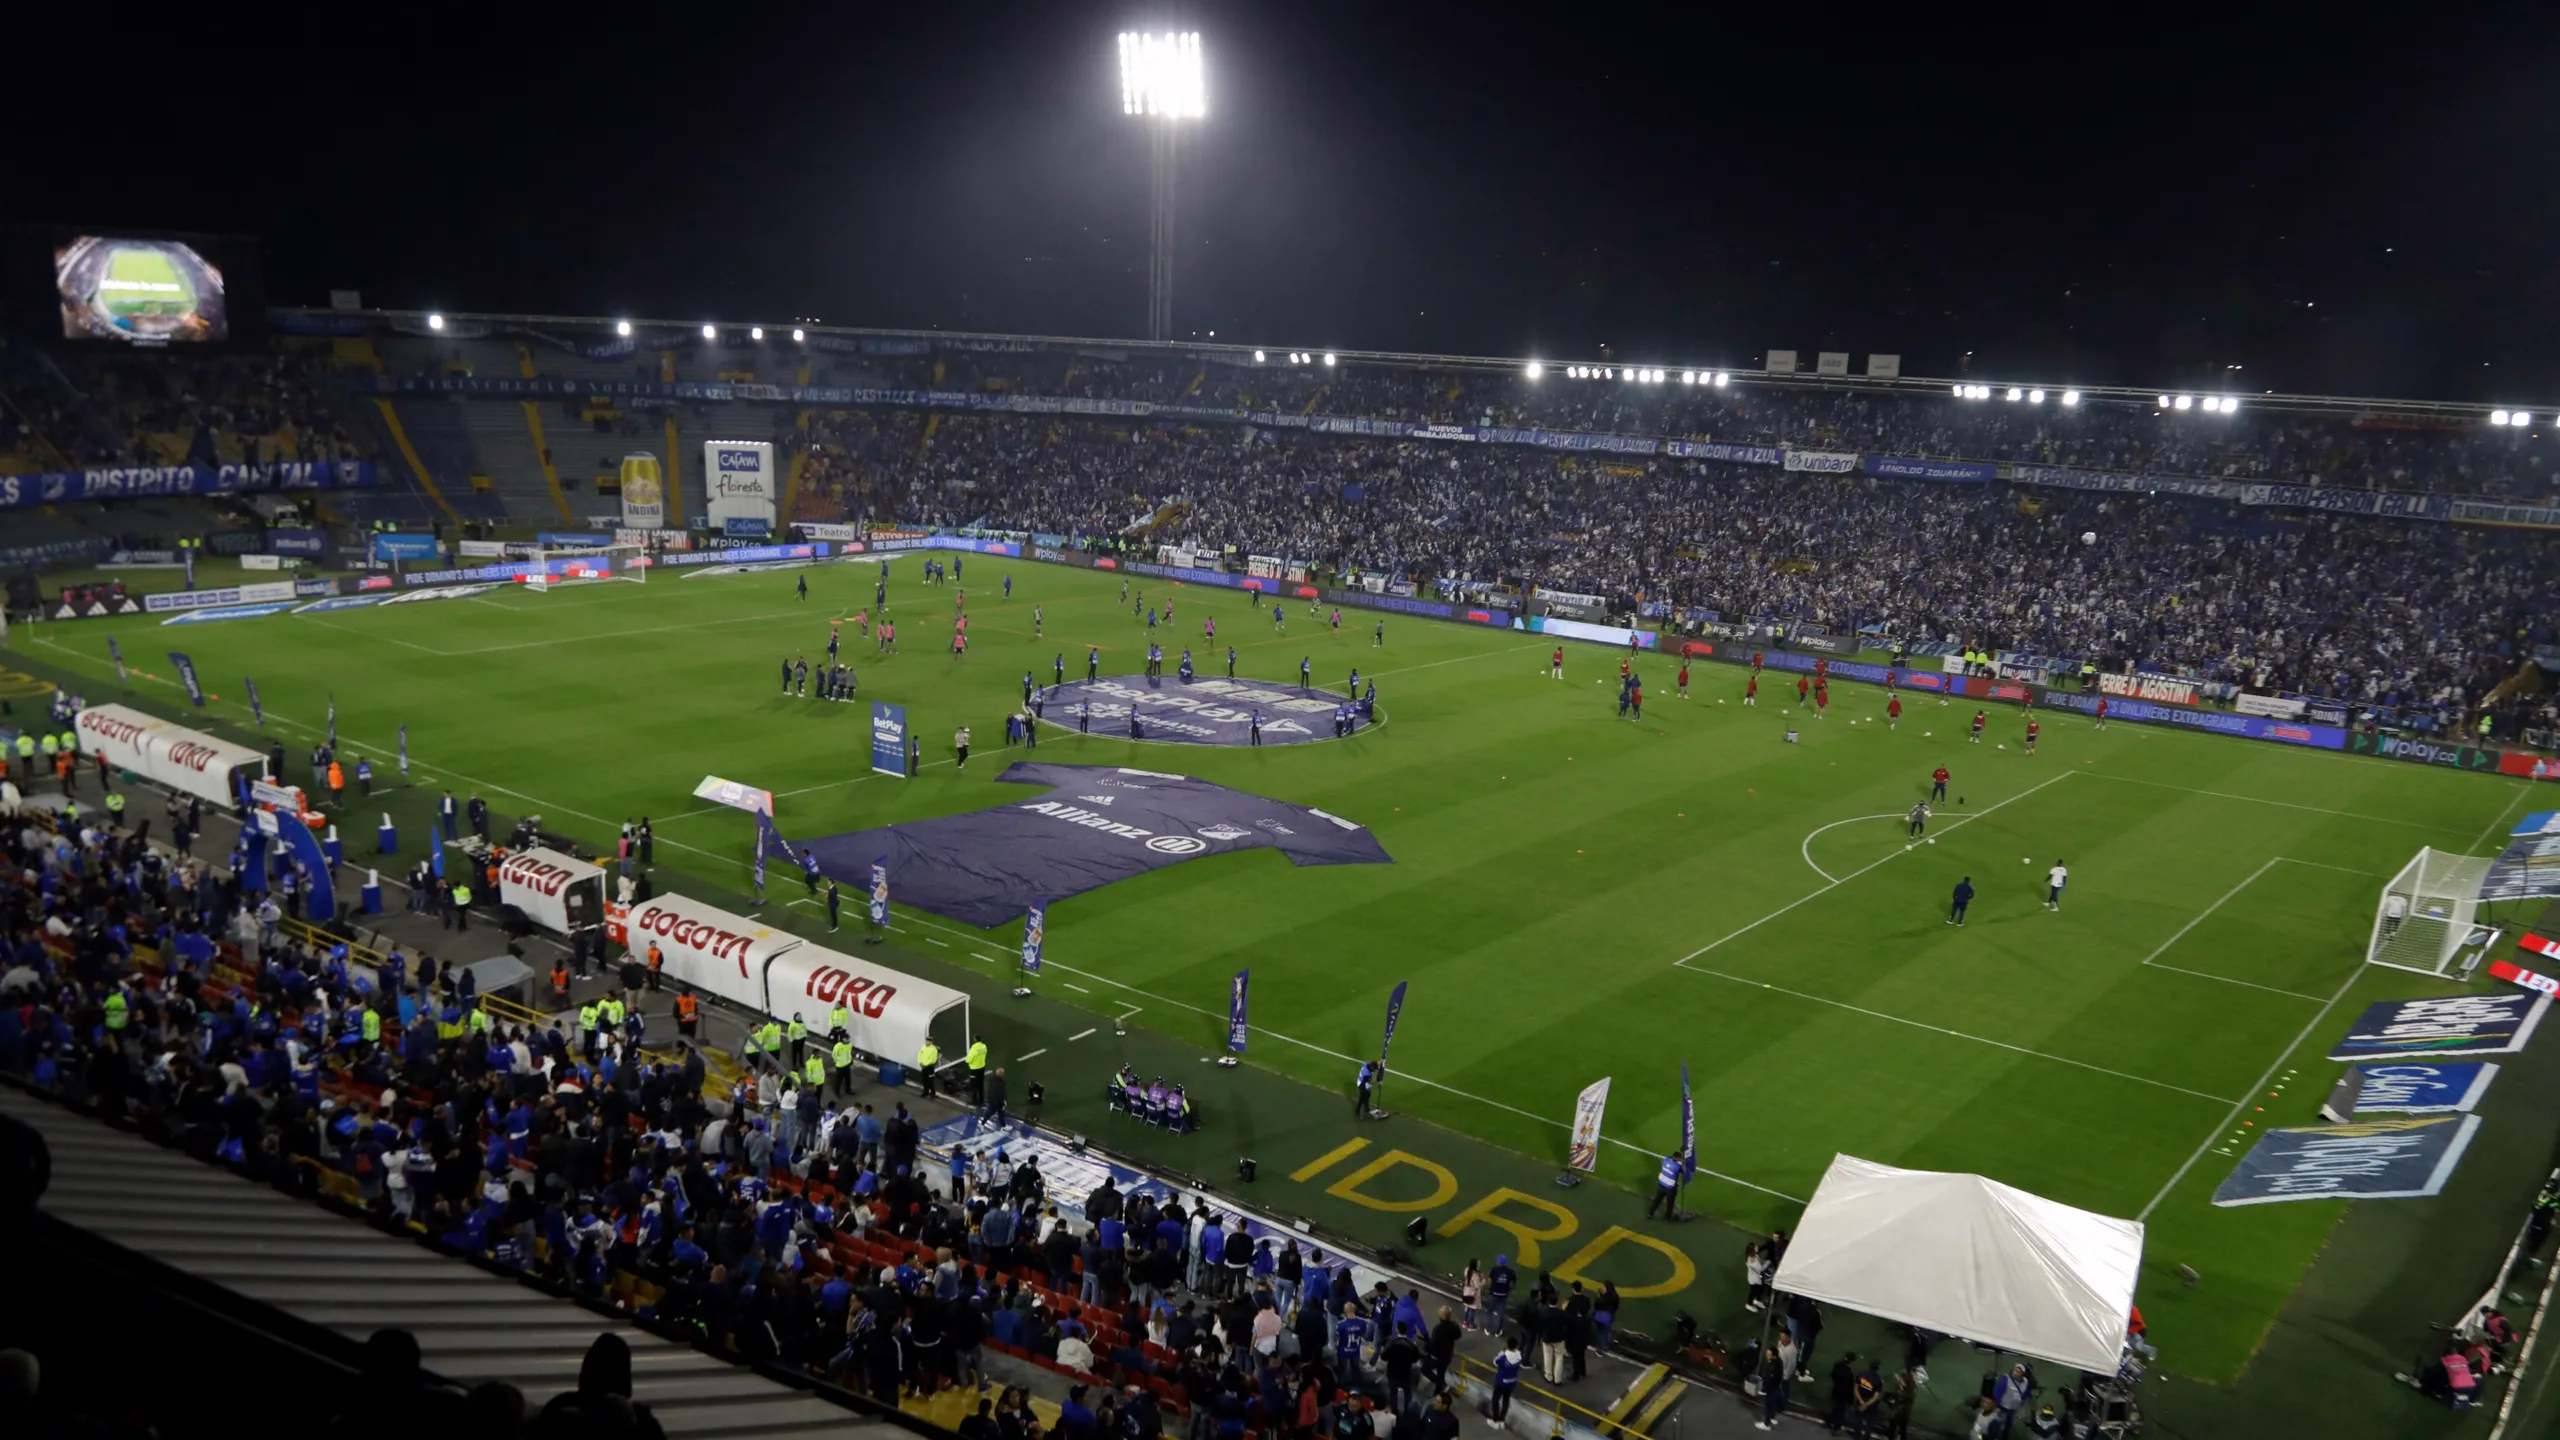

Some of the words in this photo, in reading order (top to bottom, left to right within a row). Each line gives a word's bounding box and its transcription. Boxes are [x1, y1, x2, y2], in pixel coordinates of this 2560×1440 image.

[1413, 430, 1476, 442] EMBAJADORES
[1428, 424, 1463, 434] NUEVOS
[1549, 433, 1590, 450] ESTRELLA
[1667, 441, 1682, 456] EL
[1685, 443, 1731, 461] RINCON
[1744, 448, 1780, 465] AZUL
[1804, 455, 1854, 472] unibam
[716, 474, 764, 498] floresta
[628, 504, 661, 516] ANDINA
[819, 528, 851, 538] Teatro
[663, 554, 678, 565] PIDE
[405, 572, 424, 585] PIDE
[426, 570, 462, 583] DOMINO'S
[578, 569, 598, 578] LED
[1249, 561, 1269, 579] PIERRE
[2142, 679, 2194, 704] AGOSTINY
[2045, 691, 2069, 705] PIDE
[2120, 701, 2170, 720] ONLINERS
[2171, 707, 2249, 732] EXTRAGRANDE
[873, 716, 903, 735] BetPlay
[1019, 800, 1154, 840] Allianz
[503, 855, 575, 897] IDRD
[2516, 970, 2559, 994] LED
[806, 965, 898, 1020] IDRD
[1288, 1136, 1697, 1299] IDRD
